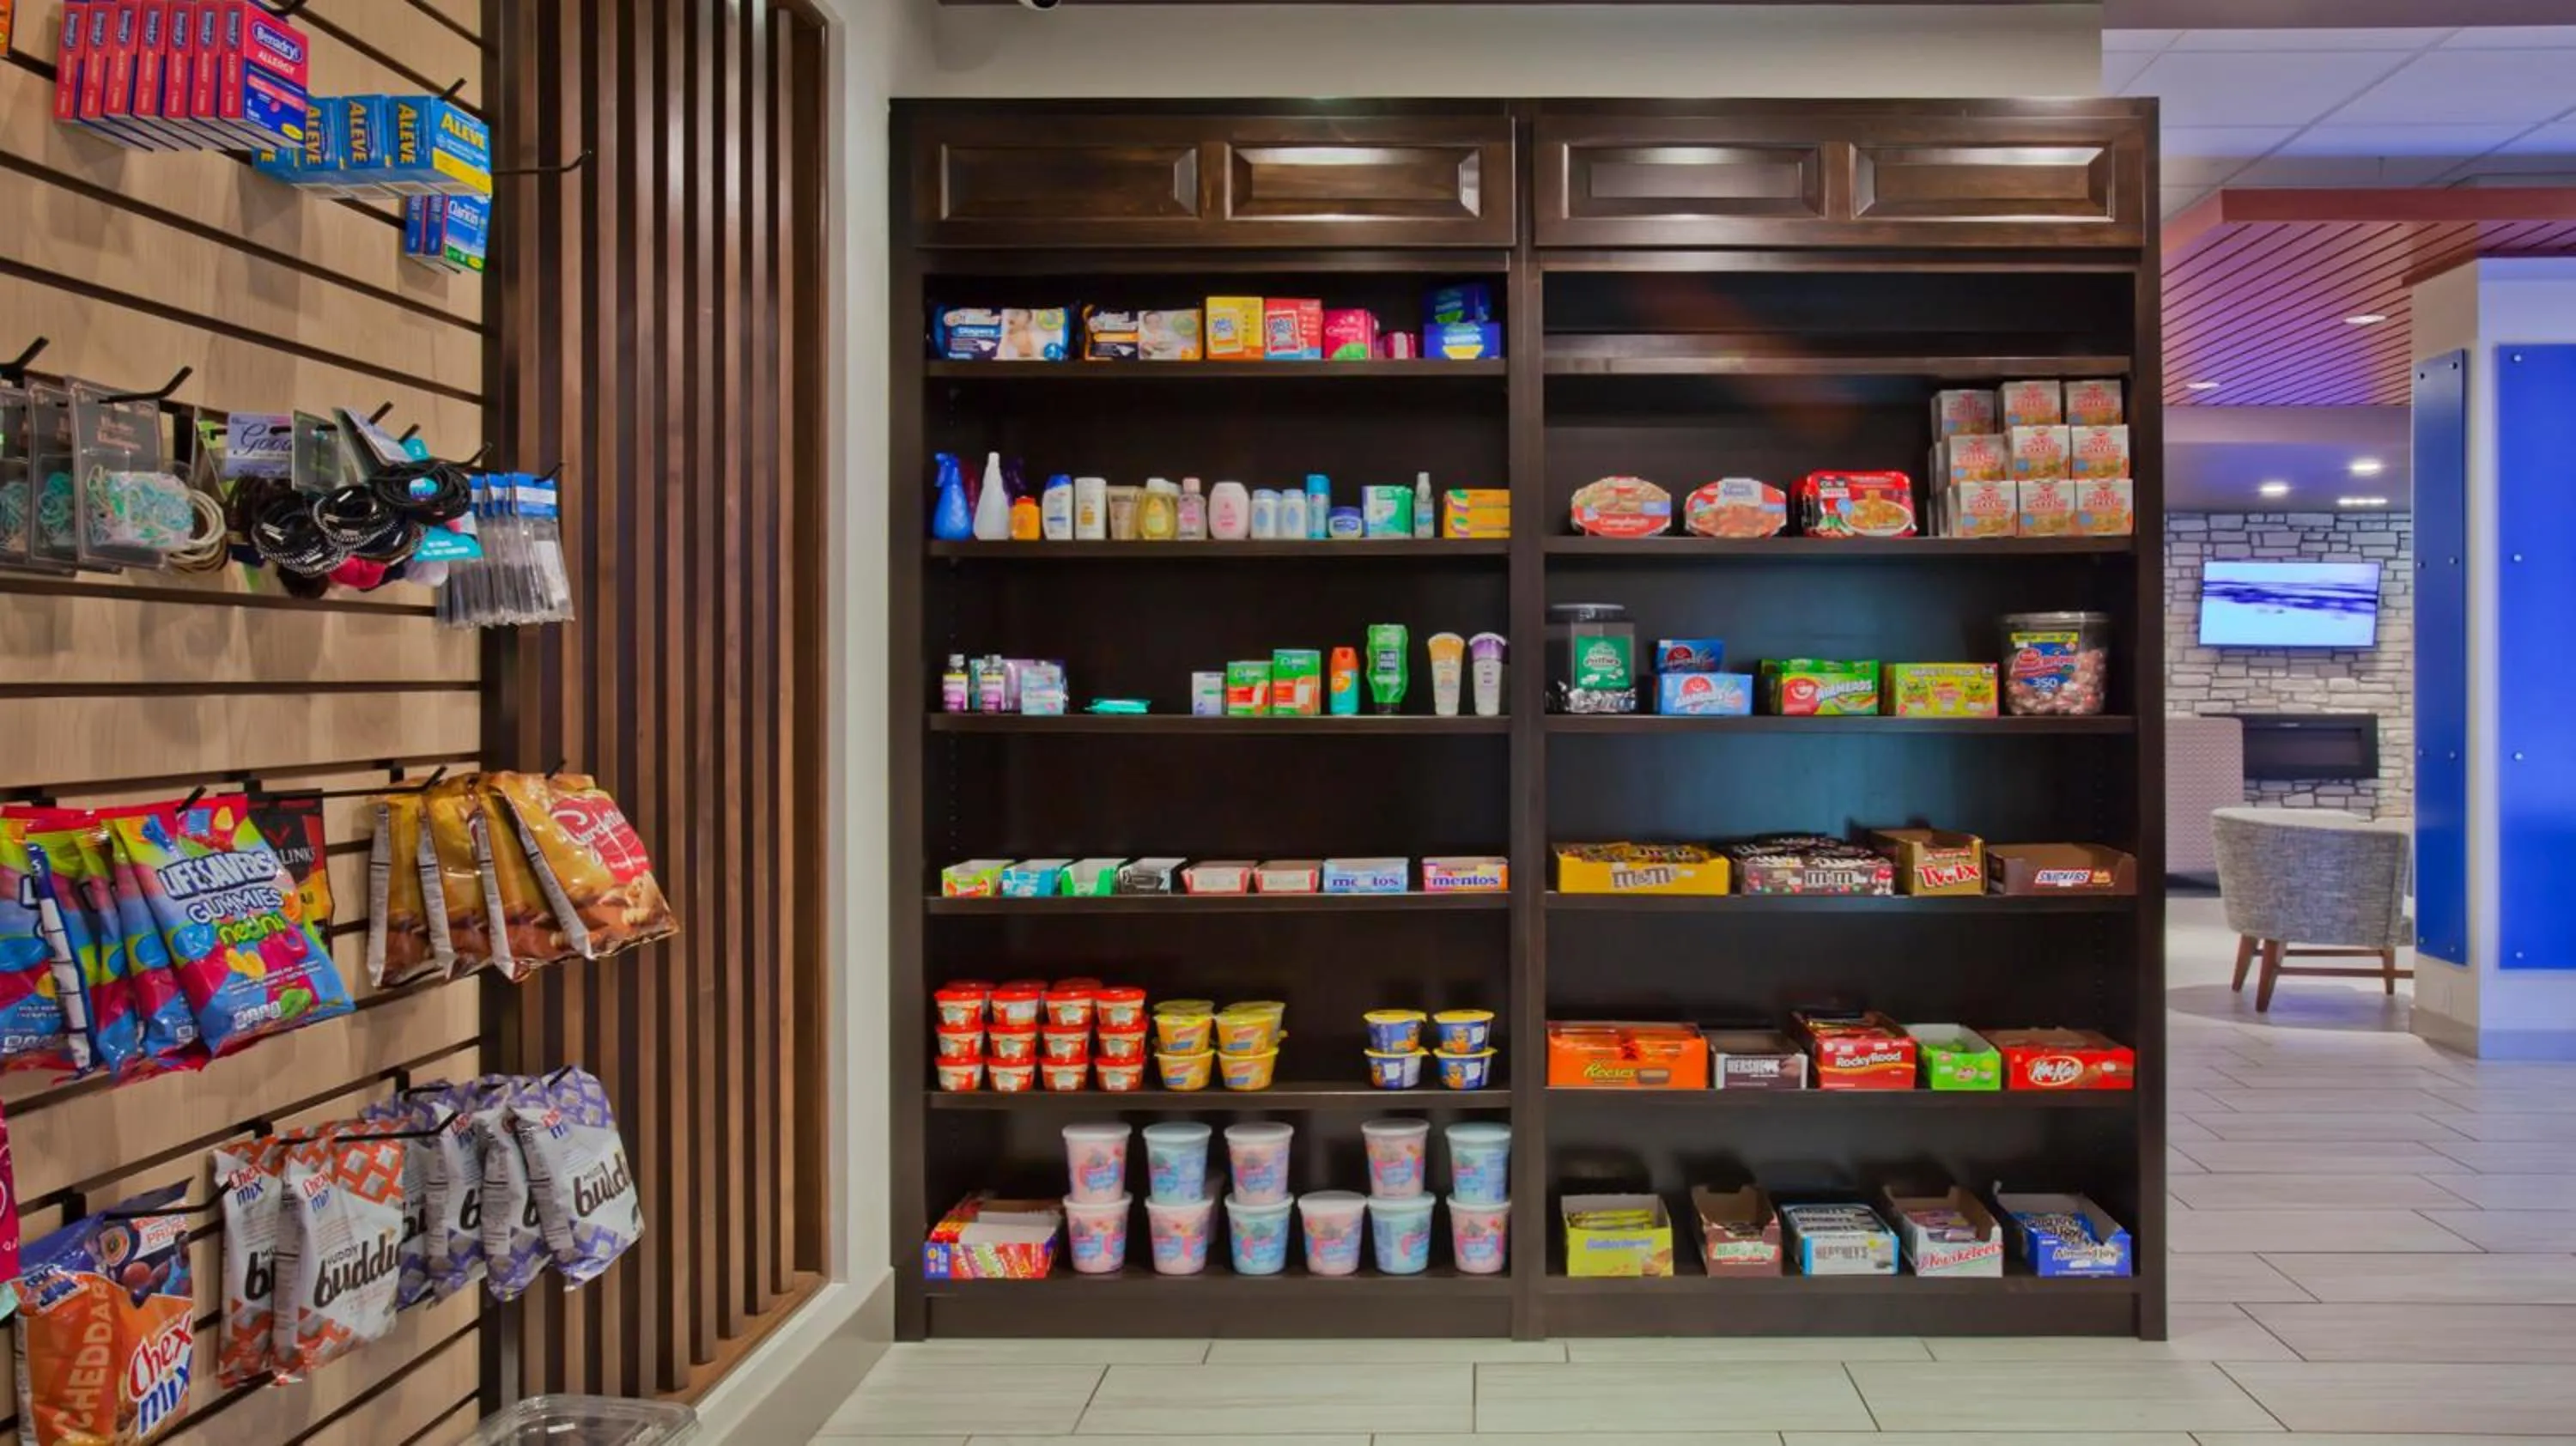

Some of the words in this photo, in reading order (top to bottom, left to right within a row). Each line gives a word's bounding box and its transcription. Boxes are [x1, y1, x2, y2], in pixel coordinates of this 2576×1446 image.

[256, 26, 301, 60] Benadryl
[258, 50, 295, 75] ALLERGY
[305, 106, 322, 165] ALEVE
[349, 100, 368, 163] ALEVE
[398, 103, 419, 164] ALEVE
[440, 111, 486, 150] ALEVE
[158, 852, 277, 900] LIFESAVERS
[1432, 874, 1500, 887] mentos
[2038, 871, 2090, 881] SNICKERS
[186, 886, 284, 924] GUMMIES
[52, 1281, 112, 1431] CHEDDAR
[130, 1315, 192, 1397] Chex
[140, 1348, 192, 1434] mix
